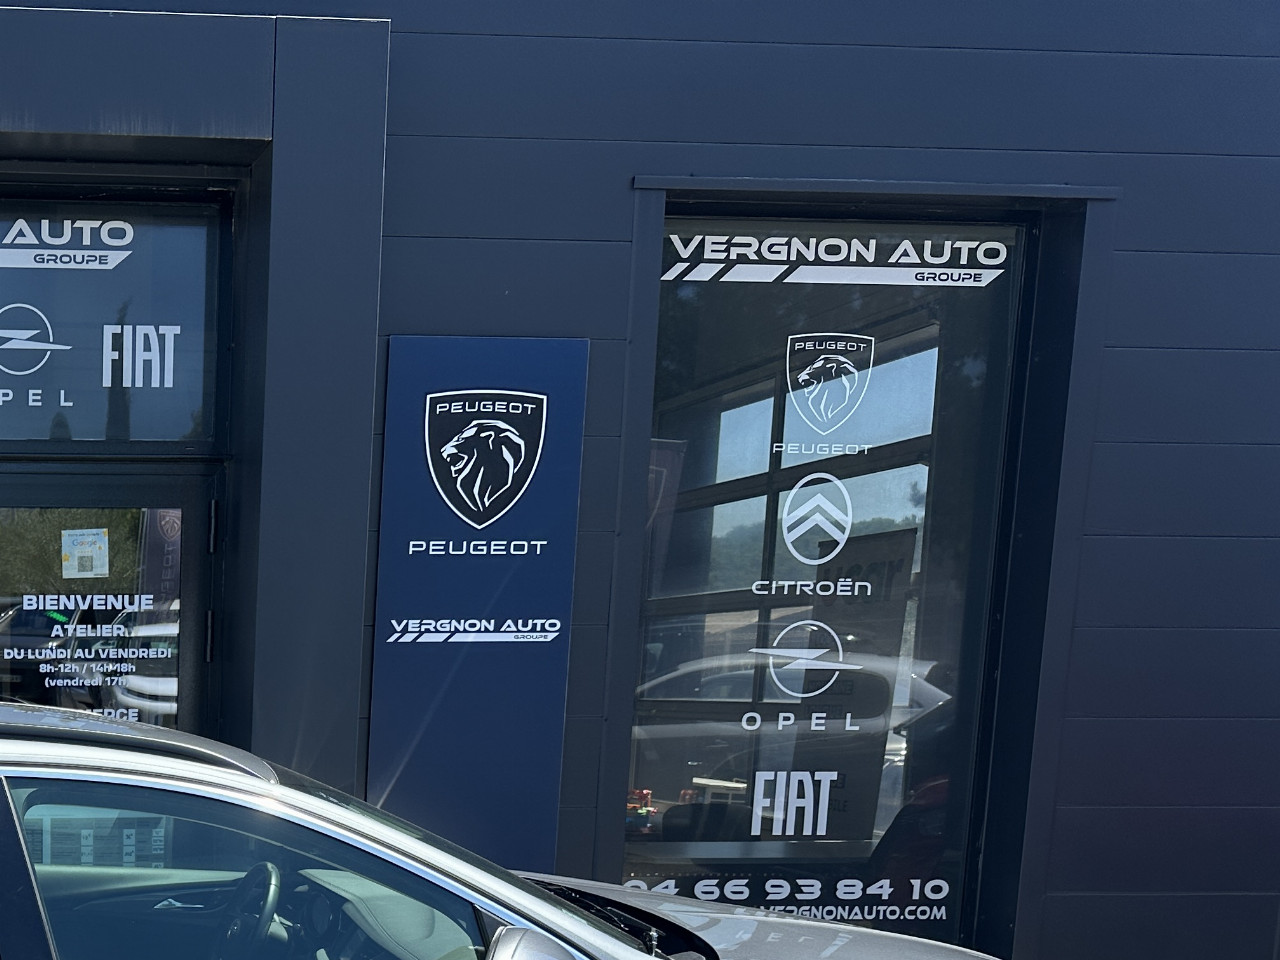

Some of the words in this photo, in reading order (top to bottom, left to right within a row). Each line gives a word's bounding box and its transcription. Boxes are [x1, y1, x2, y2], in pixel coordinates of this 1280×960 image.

[2, 218, 134, 246] AUTO
[669, 234, 877, 263] VERGNON
[887, 239, 1008, 266] AUTO
[33, 253, 109, 265] GROUPE
[914, 271, 983, 283] GROUPE
[794, 340, 868, 352] PEUGEOT
[102, 324, 181, 388] FIAT
[436, 401, 536, 415] PEUGEOT
[772, 442, 873, 456] PEUGEOT
[408, 540, 548, 555] PEUGEOT
[23, 594, 154, 610] BIENVENUE
[50, 624, 125, 637] ATELIER
[390, 619, 495, 632] VERGNON
[500, 619, 561, 632] AUTO
[3, 648, 24, 660] DU
[28, 648, 70, 659] LUNDI
[74, 648, 95, 659] AU
[99, 648, 172, 659] VENDREDI
[39, 663, 80, 673] 8h-12h
[45, 677, 103, 688] (vendredi
[741, 711, 860, 731] OPEL
[750, 770, 838, 836] FIAT
[693, 878, 750, 900] 66
[765, 878, 822, 900] 93
[835, 878, 894, 900] 84
[909, 878, 950, 900] 10
